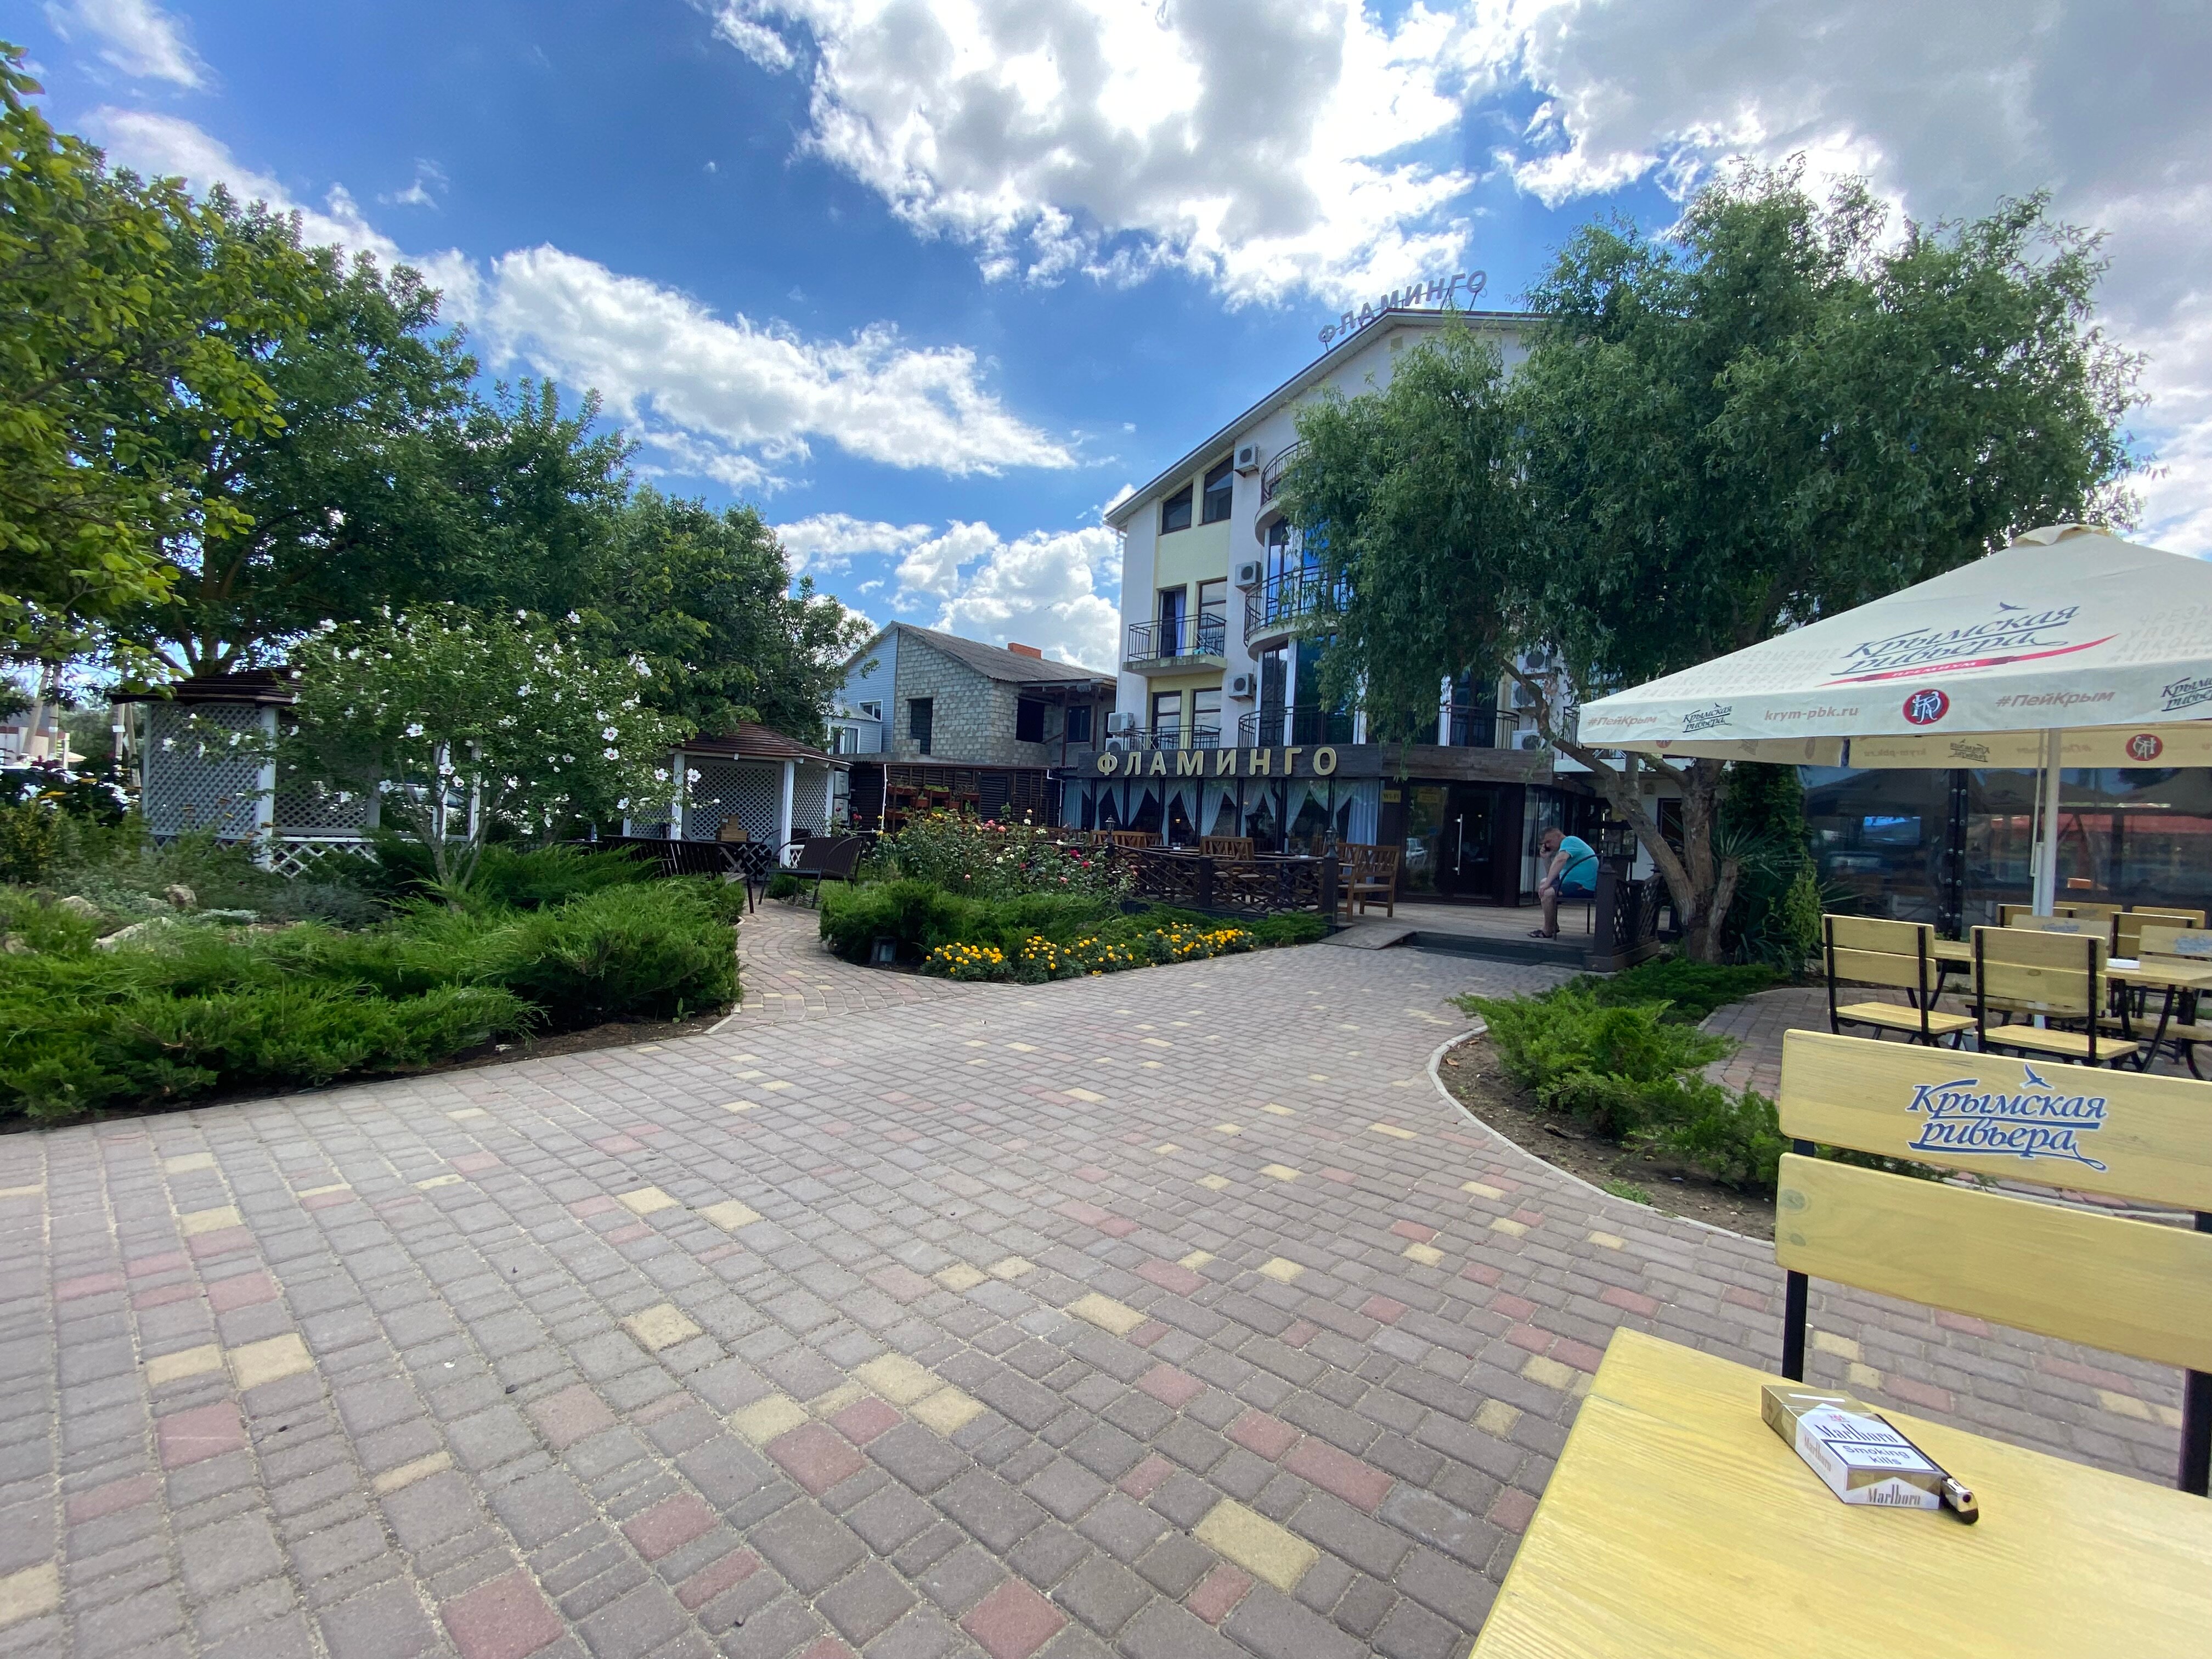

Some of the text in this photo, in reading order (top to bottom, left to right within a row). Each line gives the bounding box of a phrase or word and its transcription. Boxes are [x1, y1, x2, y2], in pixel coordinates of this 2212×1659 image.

[1318, 270, 1487, 342] ФЛАМИНГО
[1840, 605, 2081, 658] Крымская
[1843, 632, 2040, 673] ривьера
[1995, 691, 2116, 708] #ПейКрым
[1587, 715, 1657, 727] #ПейКрым
[1682, 706, 1733, 723] Крымская
[1685, 716, 1726, 731] ривьера
[1764, 706, 1859, 722] krym-pbk.ru
[1097, 747, 1338, 776] ФЛАМИНГО
[1906, 1079, 2107, 1120] Крымская
[1918, 1117, 2085, 1161] ривьера
[1814, 1423, 1899, 1443] Marlboro
[1842, 1445, 1910, 1459] Smoking
[1868, 1455, 1902, 1465] kills
[1867, 1484, 1921, 1505] Marlboro
